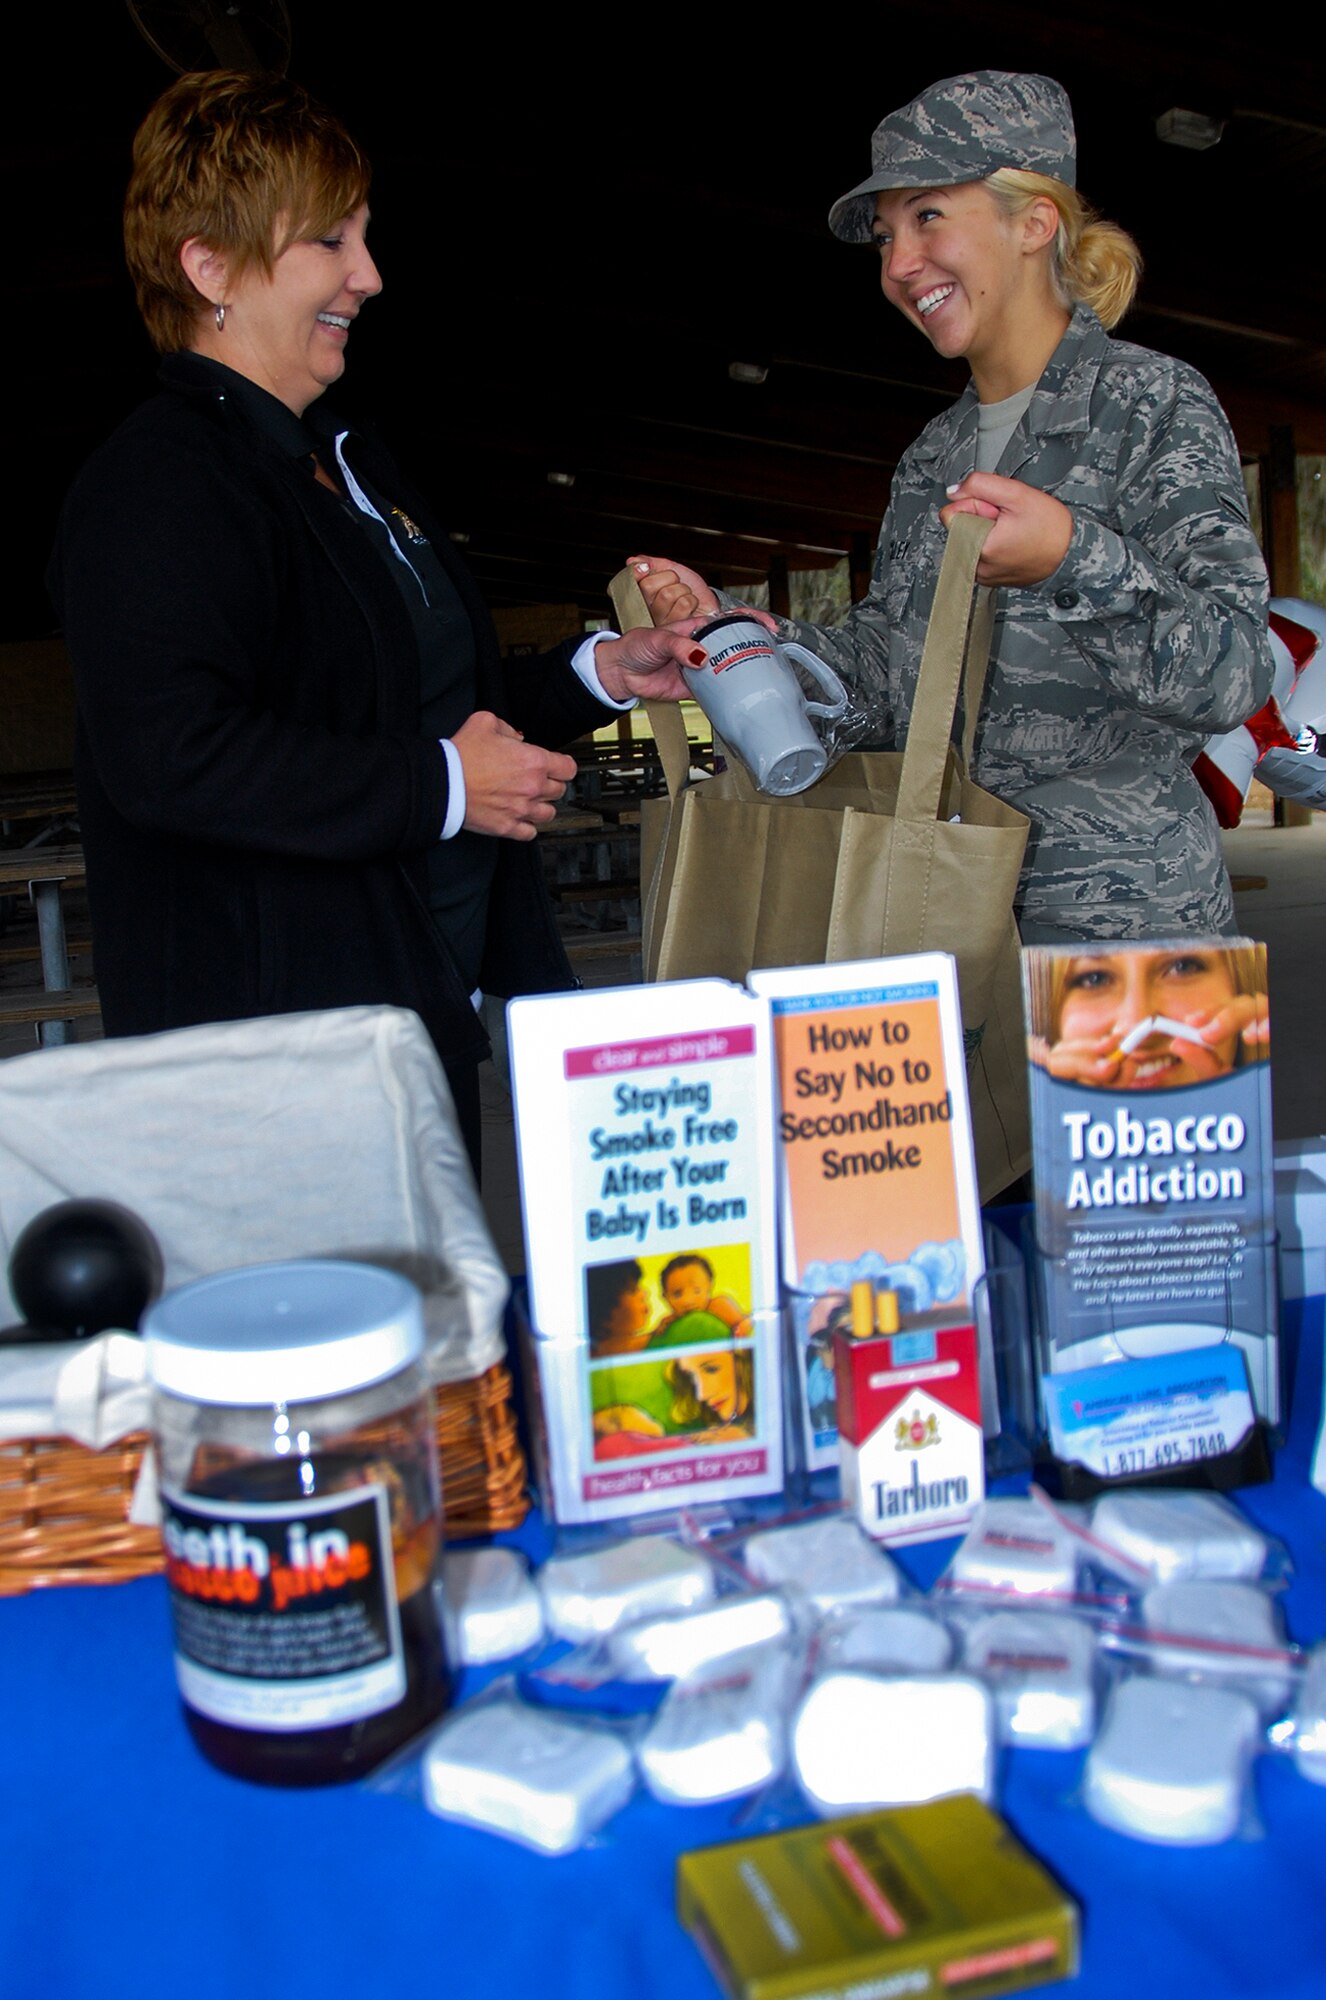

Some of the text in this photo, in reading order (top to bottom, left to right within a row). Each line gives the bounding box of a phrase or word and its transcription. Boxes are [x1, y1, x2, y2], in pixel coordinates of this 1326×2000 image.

[709, 647, 731, 667] QUIT
[730, 639, 769, 653] TOBACCO
[668, 1035, 729, 1062] simple
[810, 1019, 910, 1053] How to
[614, 1078, 711, 1117] Staying
[795, 1058, 931, 1102] Say No to
[780, 1091, 952, 1143] Secondhand
[1063, 1109, 1245, 1161] Tobacco
[591, 1114, 738, 1160] Smoke Free
[602, 1156, 729, 1199] After Your
[822, 1141, 922, 1179] Smoke
[1068, 1163, 1244, 1209] Addiction
[587, 1195, 746, 1241] Baby Is Born
[1074, 1229, 1116, 1244] Tobacco
[1118, 1230, 1135, 1240] use
[1137, 1228, 1146, 1239] is
[1147, 1225, 1184, 1239] deadly,
[1068, 1247, 1089, 1259] and
[1091, 1245, 1118, 1258] often
[1120, 1243, 1158, 1257] socially
[1232, 1237, 1247, 1248] So
[1073, 1262, 1095, 1276] why
[1136, 1259, 1183, 1271] everyone
[1184, 1254, 1212, 1268] stop?
[1086, 1294, 1108, 1306] and
[1110, 1292, 1125, 1303] he
[1156, 1290, 1170, 1300] on
[1171, 1287, 1193, 1299] how
[1196, 1287, 1206, 1298] to
[1207, 1286, 1226, 1301] qui
[1118, 1275, 1149, 1288] about
[1151, 1272, 1192, 1286] tobacco
[651, 1462, 694, 1484] facts
[696, 1459, 722, 1477] for
[727, 1455, 759, 1479] you
[872, 1461, 969, 1521] Tarboro
[288, 1520, 350, 1571] in
